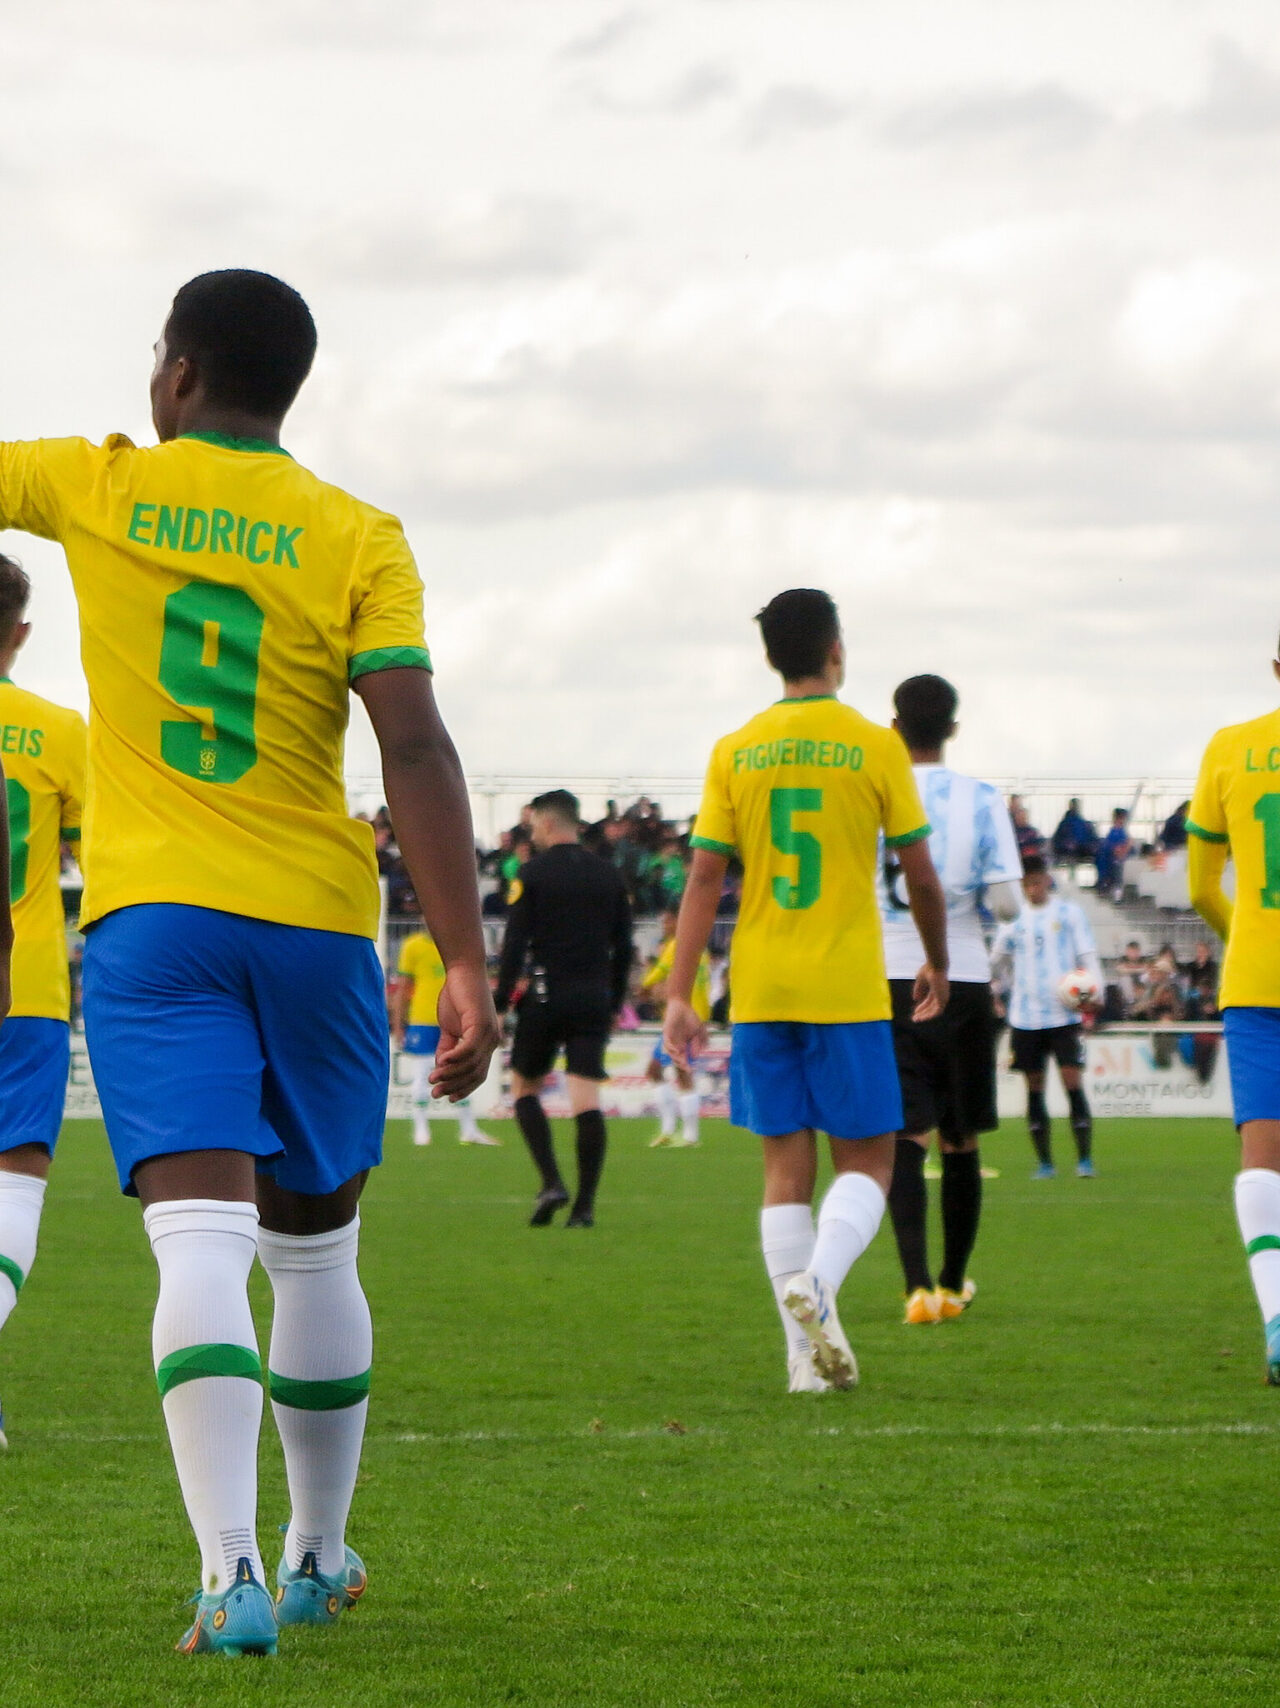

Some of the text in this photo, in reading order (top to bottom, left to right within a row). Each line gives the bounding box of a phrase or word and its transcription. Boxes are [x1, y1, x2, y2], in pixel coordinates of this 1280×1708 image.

[127, 502, 305, 570] ENDRICK
[158, 581, 266, 784] 9
[733, 738, 864, 775] FIGUEIREDO
[770, 788, 824, 909] 5
[1094, 1082, 1213, 1100] MONTAIGU
